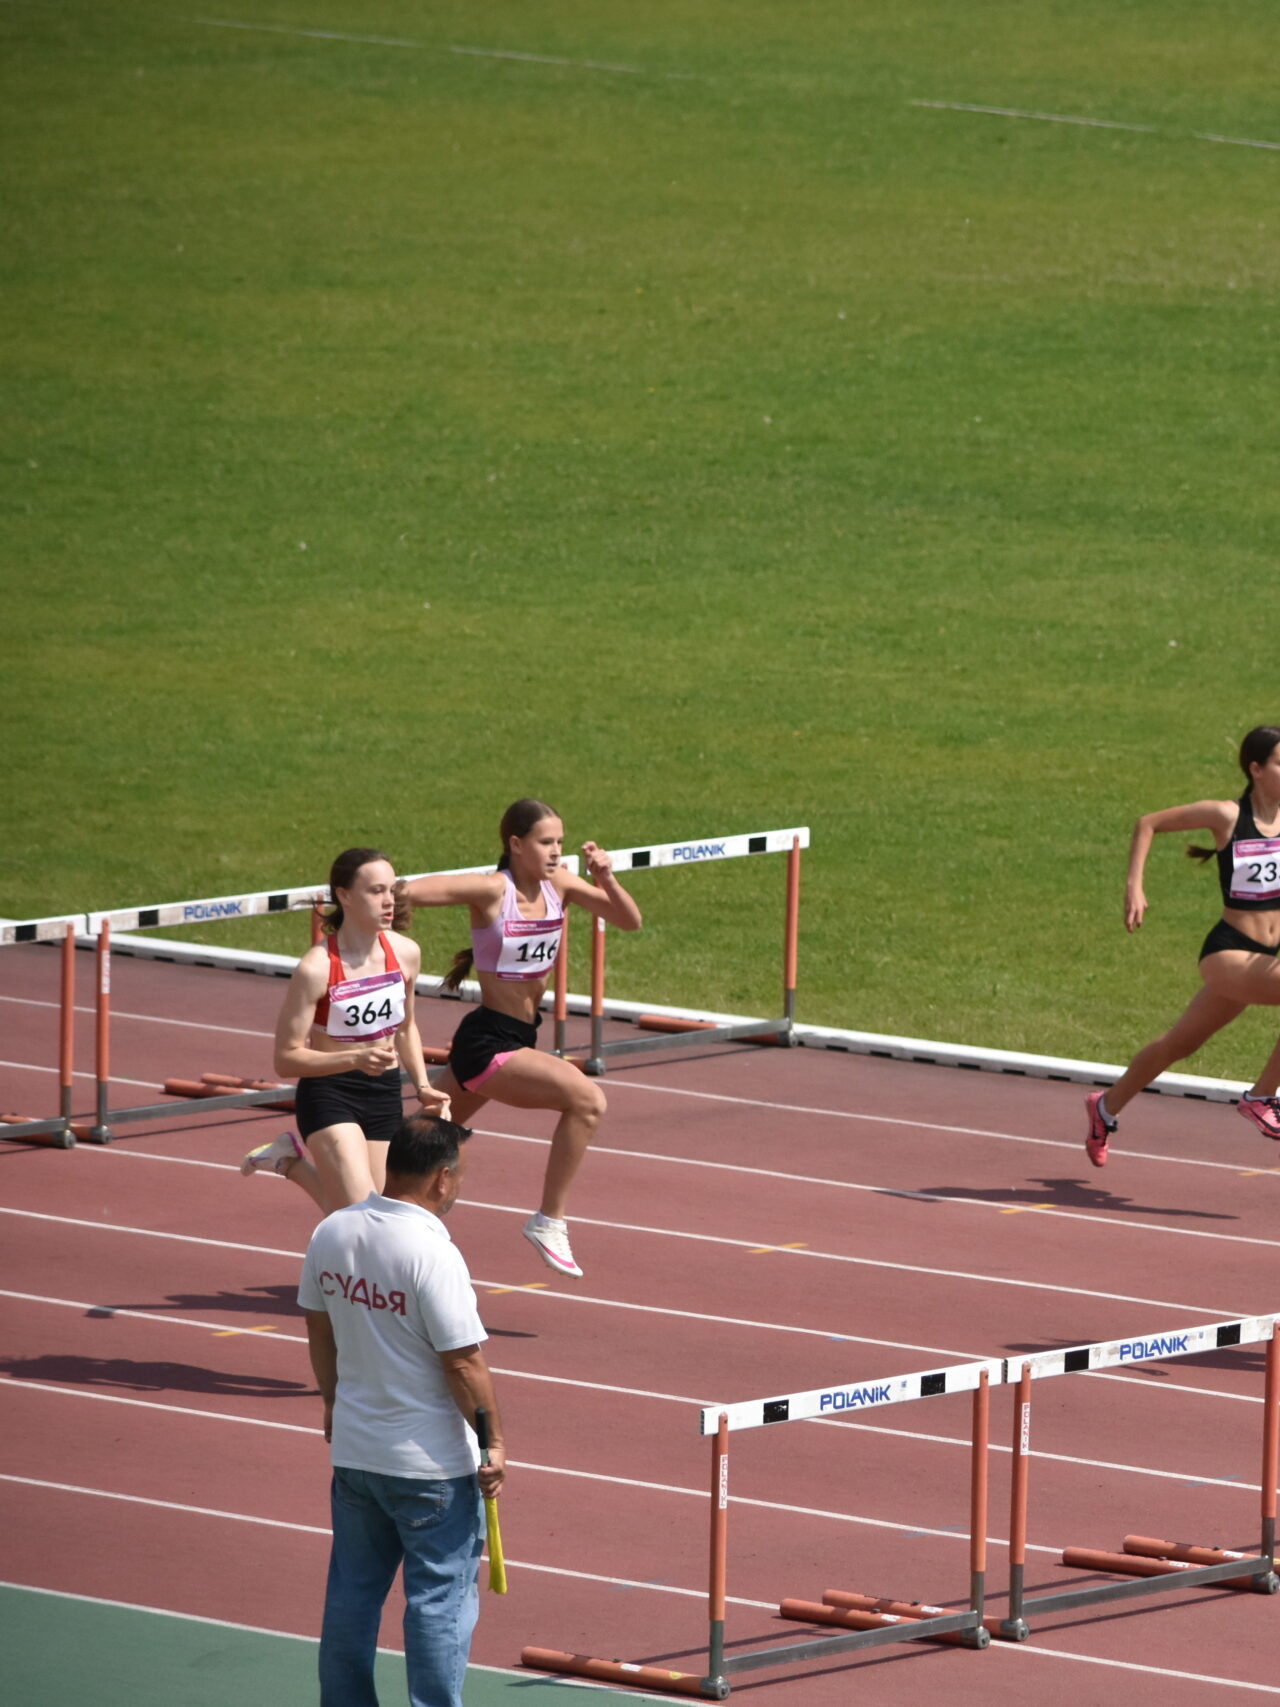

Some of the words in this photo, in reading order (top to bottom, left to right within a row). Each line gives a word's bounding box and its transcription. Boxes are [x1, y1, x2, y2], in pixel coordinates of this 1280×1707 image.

[673, 843, 725, 860] POLANIK
[184, 901, 242, 920] POLANIK
[515, 939, 558, 962] 146
[344, 998, 393, 1027] 364
[319, 1271, 407, 1316] СУДЬЯ
[1119, 1334, 1188, 1361] POLANIK
[820, 1384, 891, 1411] POLANIK
